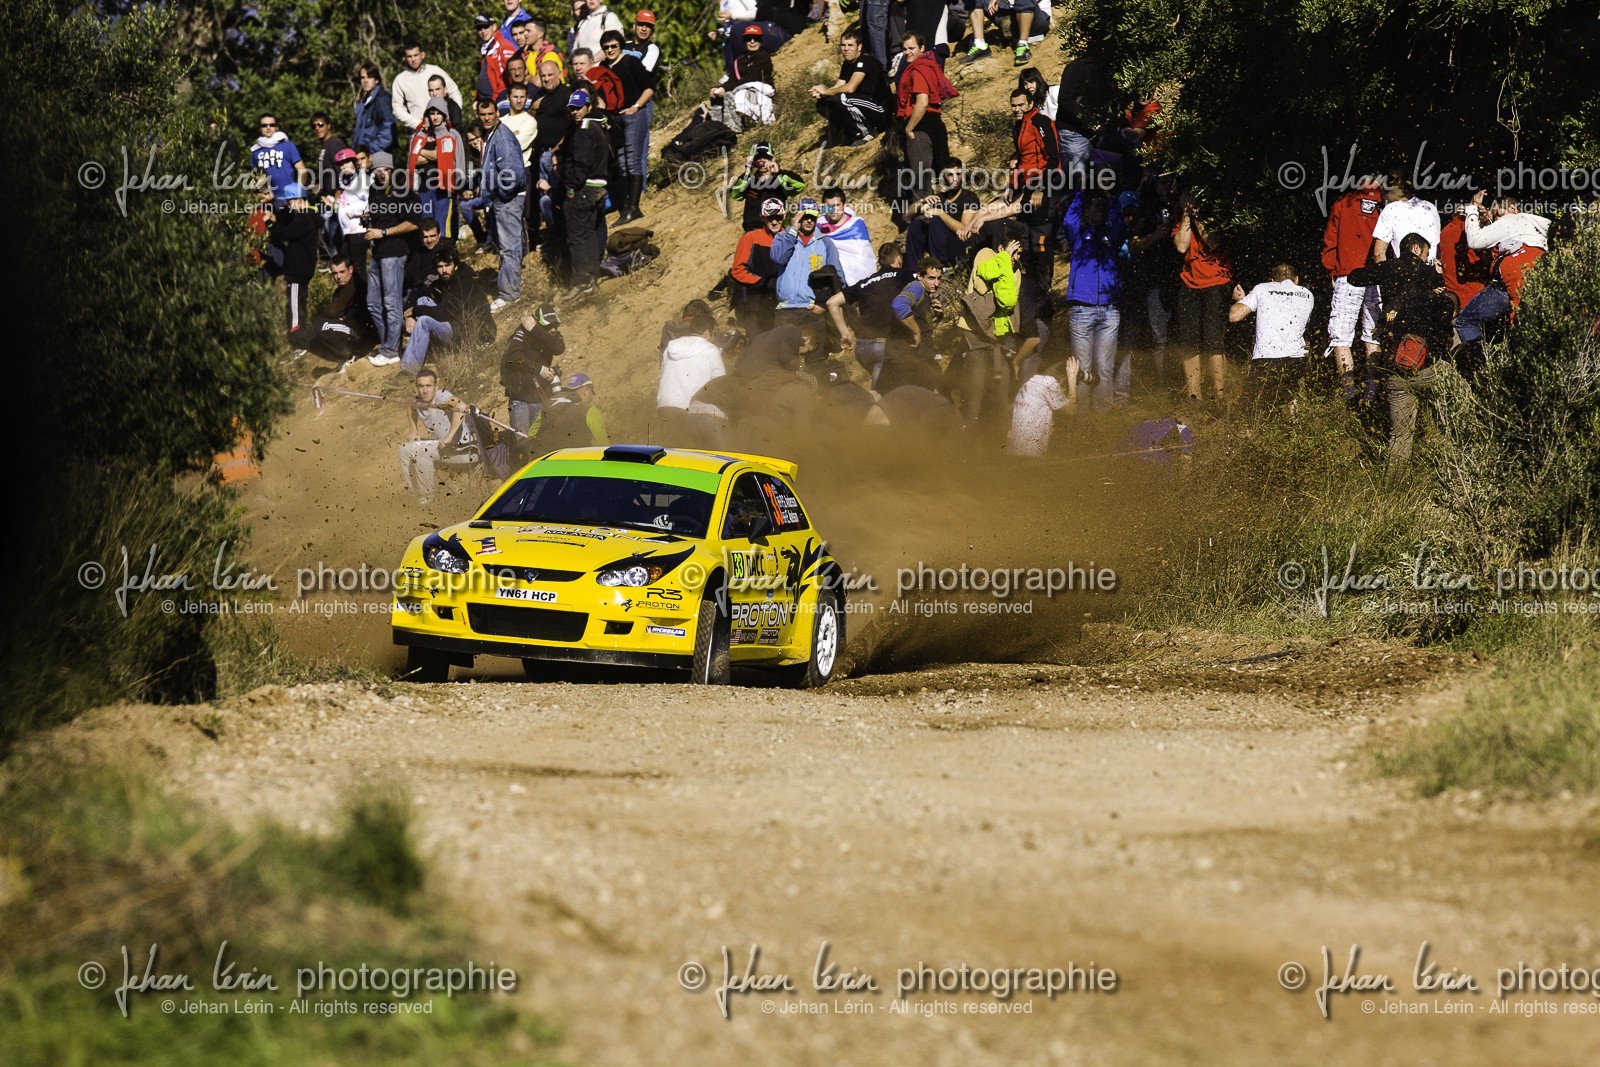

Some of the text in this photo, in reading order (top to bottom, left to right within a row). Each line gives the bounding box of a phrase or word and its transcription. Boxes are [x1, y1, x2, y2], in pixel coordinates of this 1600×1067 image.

[733, 553, 744, 578] 33
[745, 554, 765, 577] RACC
[499, 588, 556, 601] YN61 HCP
[646, 588, 683, 600] R3
[637, 601, 680, 609] PROTON
[731, 602, 788, 627] PROTON
